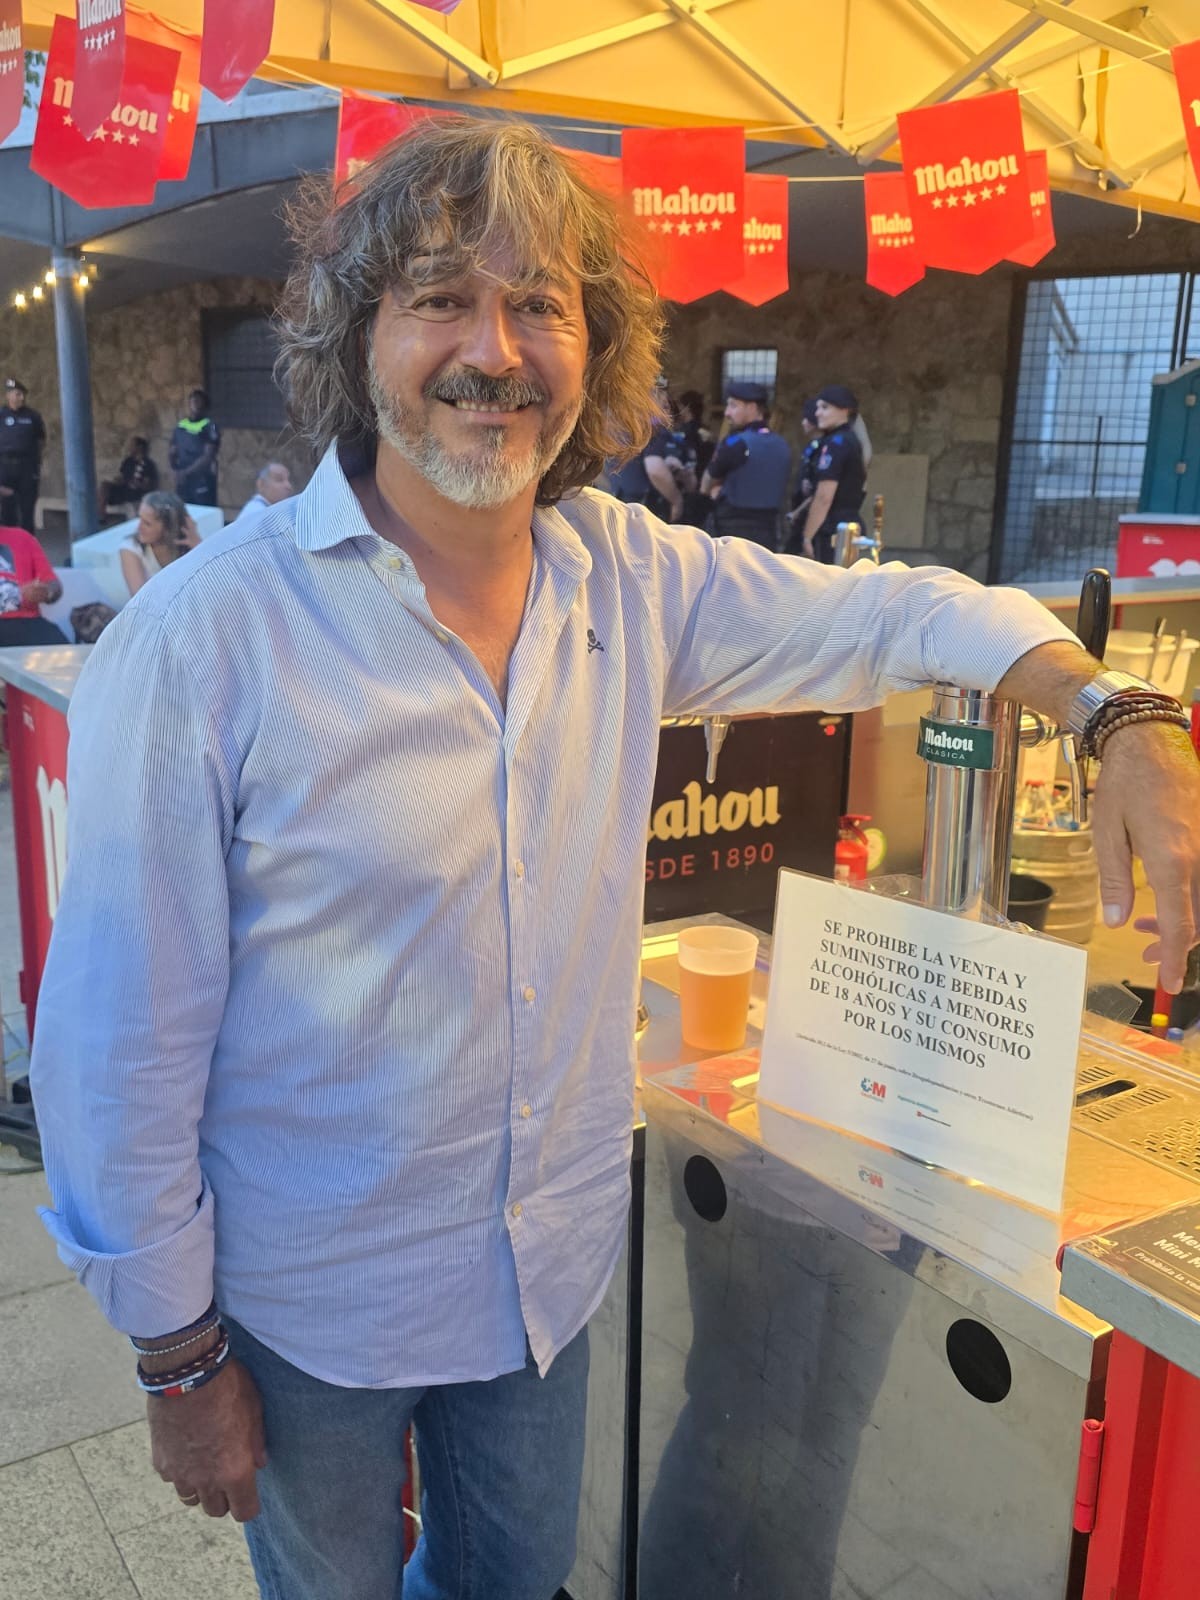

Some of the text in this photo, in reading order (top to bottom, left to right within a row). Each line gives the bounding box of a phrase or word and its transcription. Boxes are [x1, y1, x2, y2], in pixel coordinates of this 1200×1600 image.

[913, 155, 1019, 195] Mahou
[632, 186, 736, 216] Mahou
[743, 217, 782, 240] ahou
[870, 213, 913, 235] Maho
[924, 727, 974, 752] Mahou
[648, 781, 781, 842] ahou
[646, 842, 774, 881] SDE 1890
[824, 920, 1027, 989] SE PROHIBE LA VENTA Y
[820, 939, 1027, 1013] SUMINISTRO DE BEBIDAS
[809, 977, 1031, 1060] DE 18 AÑOS Y SU CONSUMO
[810, 958, 1035, 1039] ALCOHÓLICAS A MENORES
[843, 1009, 876, 1031] POR
[881, 1021, 912, 1043] LOS
[916, 1032, 986, 1068] MISMOS
[1153, 1239, 1192, 1259] Mini
